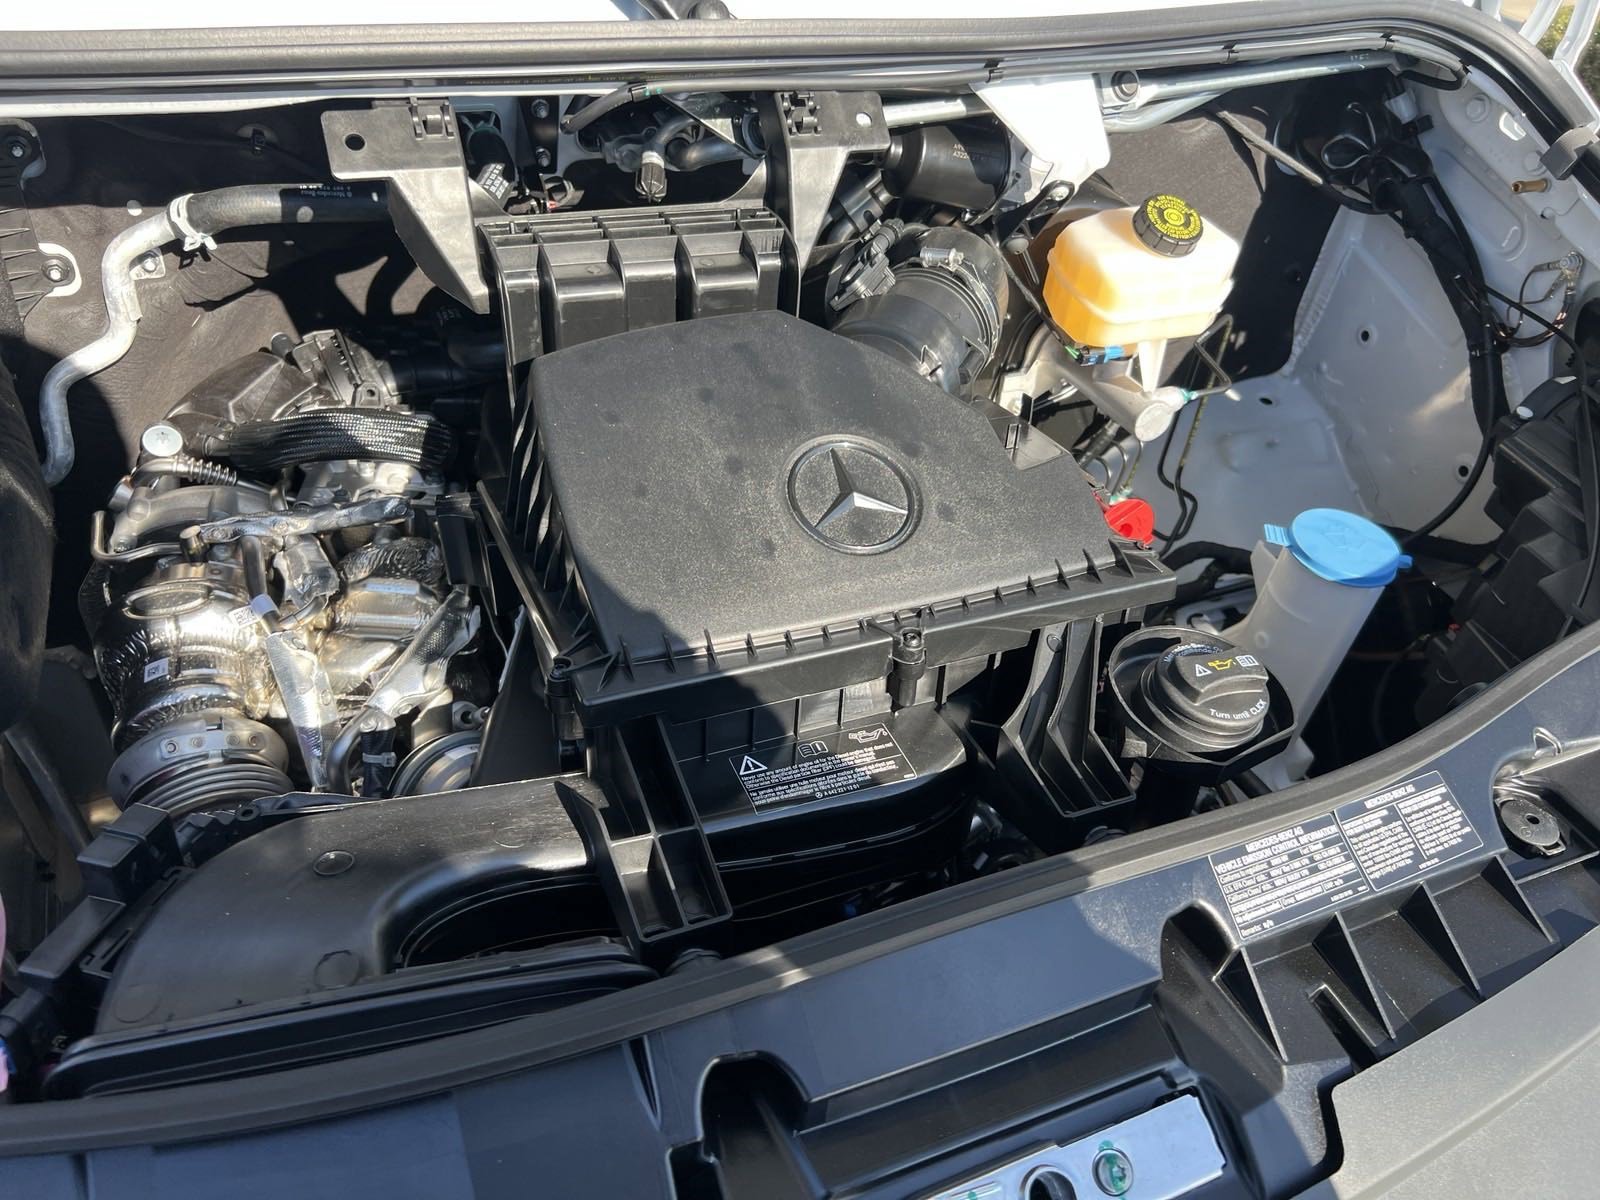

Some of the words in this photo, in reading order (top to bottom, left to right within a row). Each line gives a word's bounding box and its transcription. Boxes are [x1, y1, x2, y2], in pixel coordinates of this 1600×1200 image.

[1210, 708, 1231, 720] Turn
[1232, 710, 1250, 720] until
[1214, 856, 1243, 874] VEHICLE
[1241, 846, 1272, 864] EMISSION
[1270, 837, 1300, 854] CONTROL
[1297, 824, 1338, 845] INFORMATION
[1244, 828, 1295, 853] MERCEDES-BENZ
